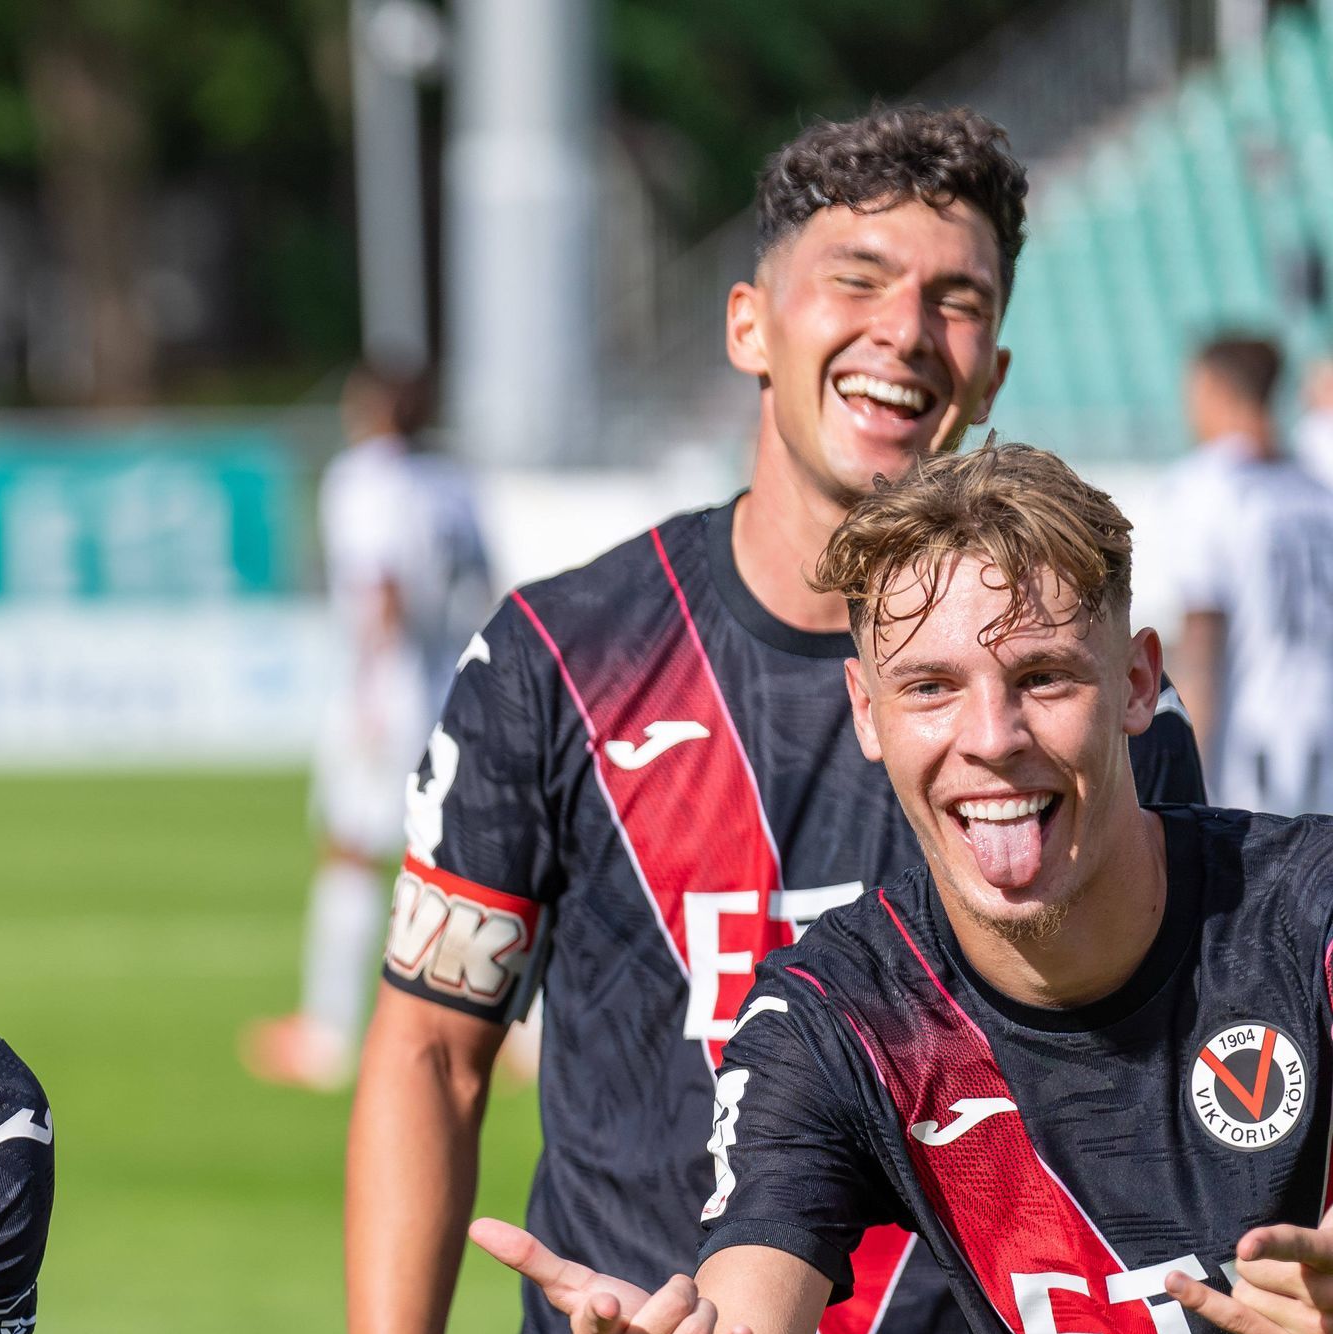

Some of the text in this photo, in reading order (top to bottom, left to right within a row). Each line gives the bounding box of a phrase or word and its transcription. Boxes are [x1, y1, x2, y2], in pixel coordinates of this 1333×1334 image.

[1219, 1028, 1256, 1051] 1904
[1196, 1060, 1303, 1144] VIKTORIA KÖLN
